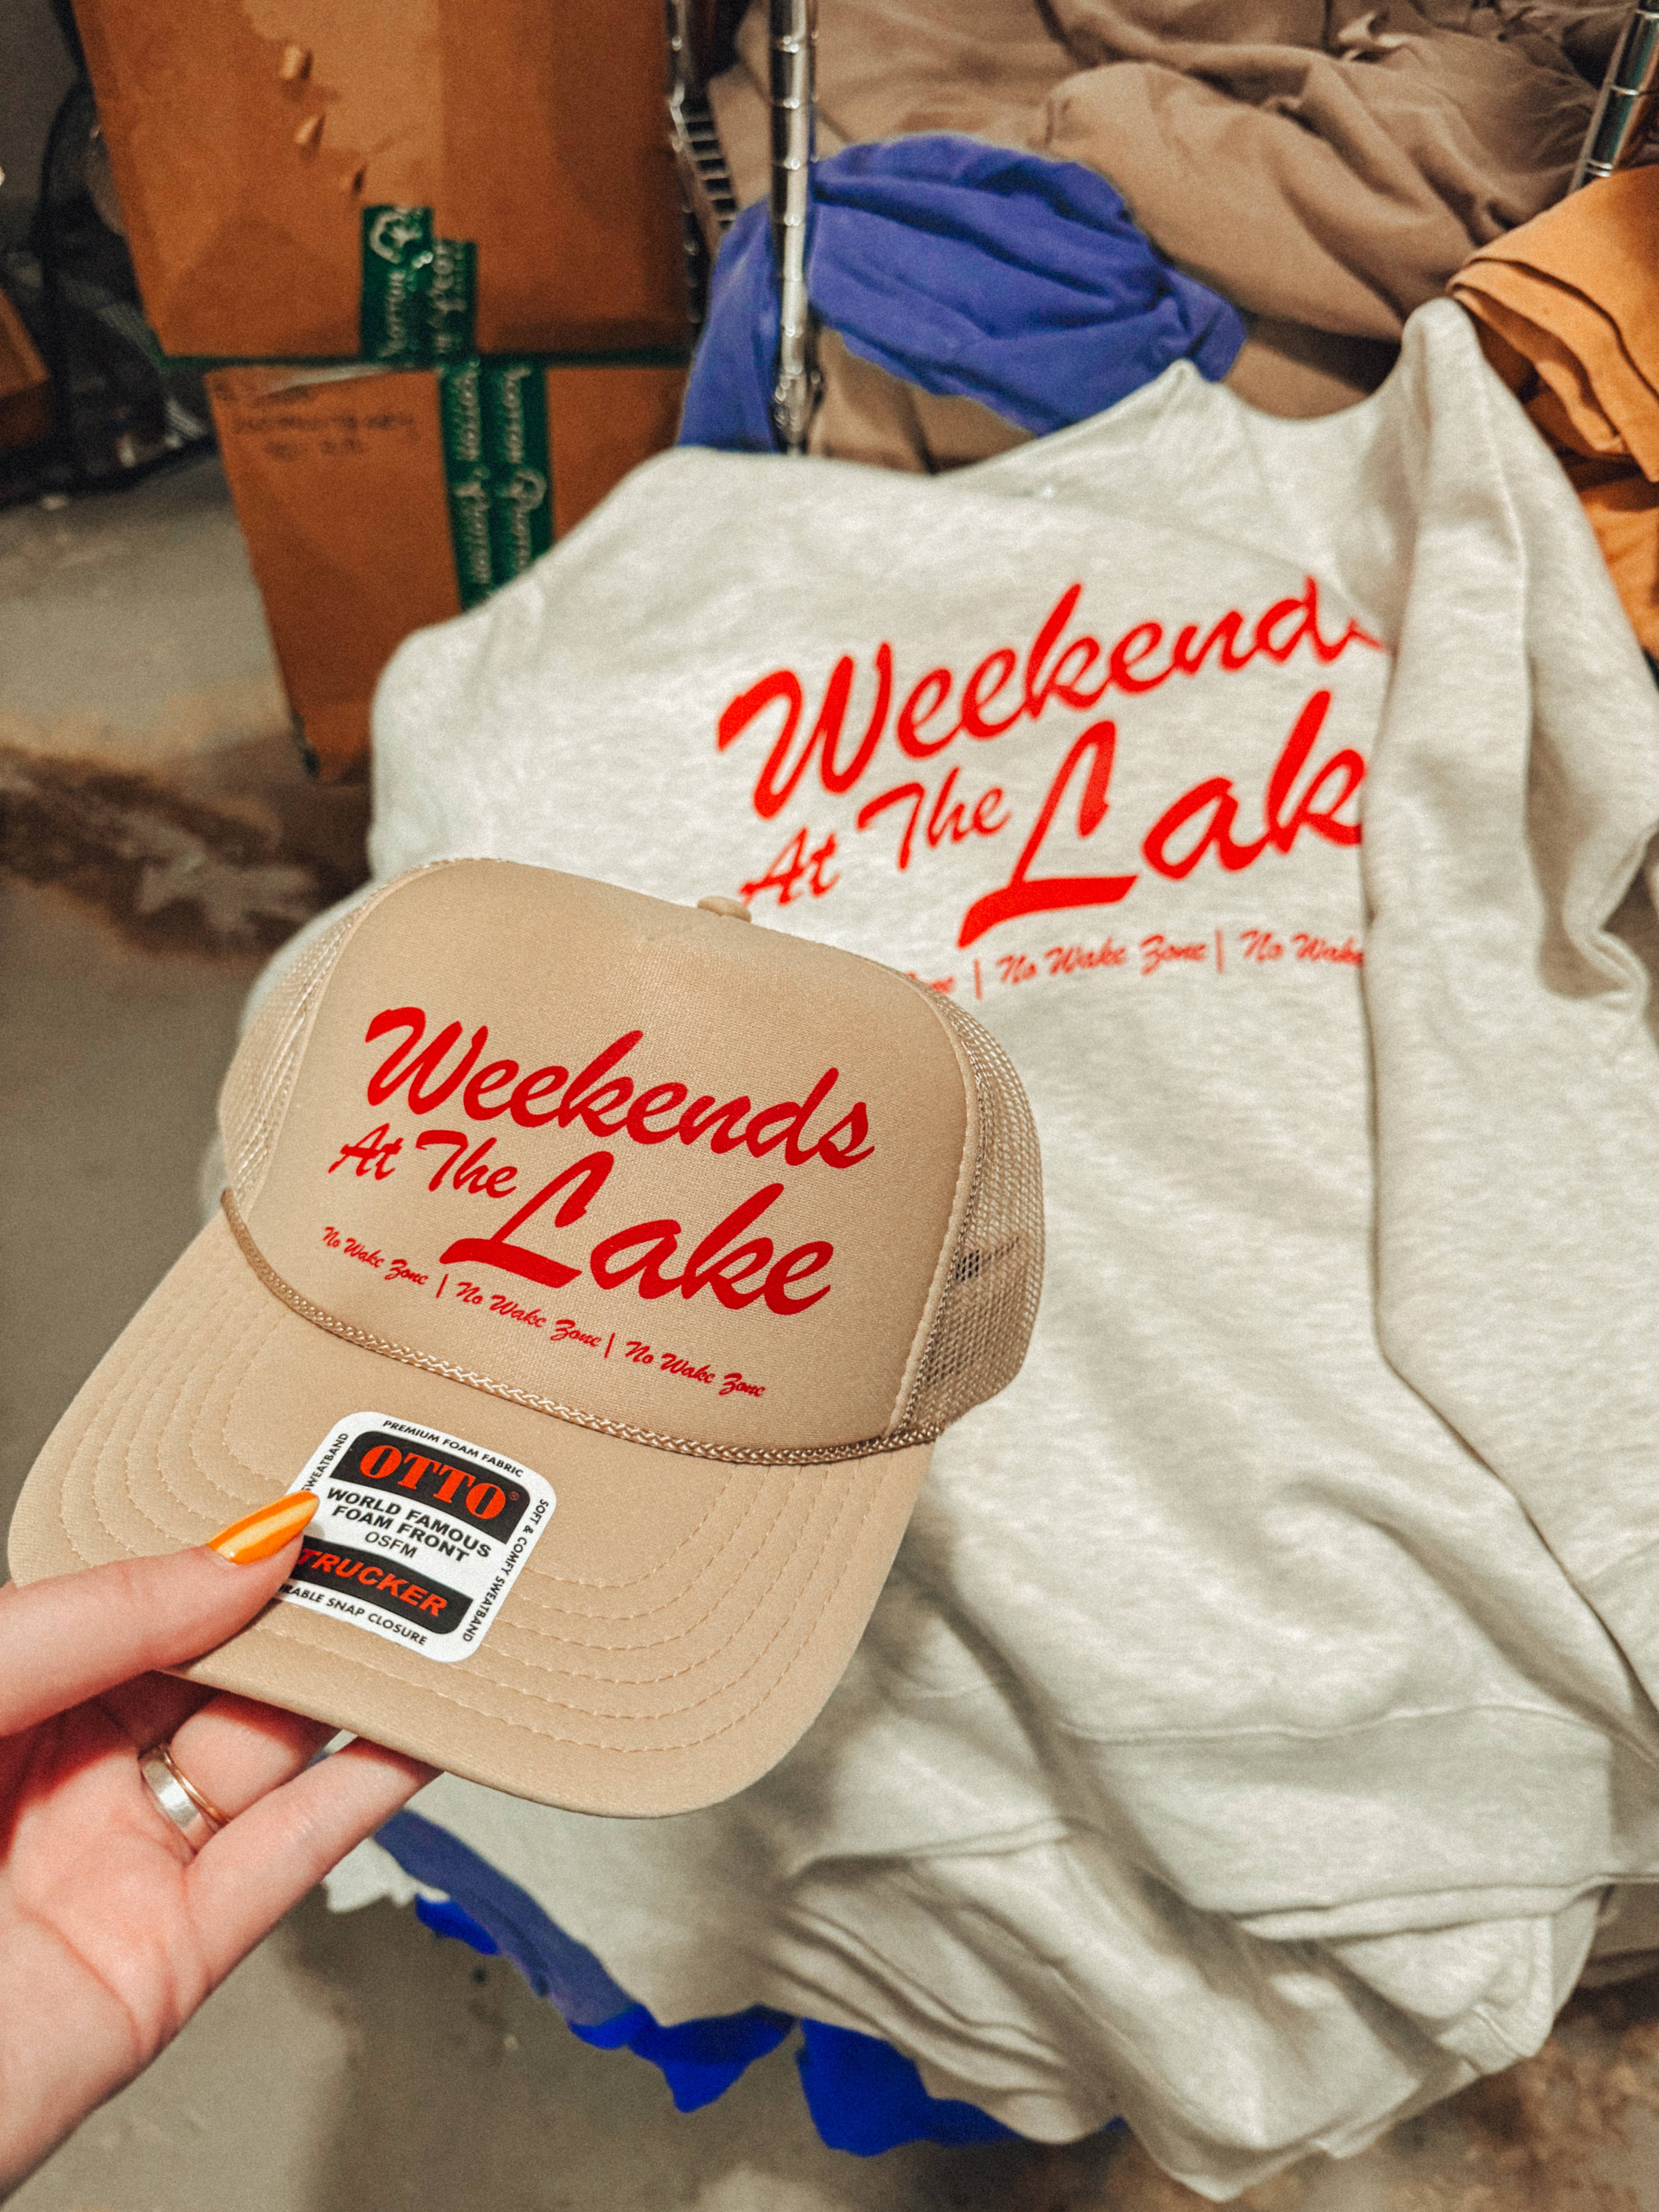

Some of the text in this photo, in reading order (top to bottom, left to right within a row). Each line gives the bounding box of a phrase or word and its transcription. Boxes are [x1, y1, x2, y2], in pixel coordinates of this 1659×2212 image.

[739, 689, 1369, 950] At The Lak
[996, 955, 1038, 984] No
[1044, 937, 1126, 975] Wake
[1140, 933, 1206, 975] Zone
[1240, 929, 1283, 962] No
[364, 1006, 875, 1170] Weekends
[328, 1122, 834, 1316] At The Lake
[323, 1226, 341, 1248] No
[343, 1237, 385, 1268] Wake
[384, 1259, 429, 1285] Zone
[456, 1281, 484, 1305] No
[489, 1294, 547, 1328] Wake
[550, 1319, 602, 1348] Zone
[624, 1341, 654, 1364] No
[660, 1352, 716, 1384] Wake
[718, 1372, 766, 1397] Zone
[359, 1445, 506, 1519] OTTO
[383, 1420, 524, 1478] PREMIUM FOAM FABRIC
[327, 1487, 491, 1558] WORLD FAMOUS
[331, 1505, 470, 1562] FOAM FRONT
[365, 1532, 418, 1558] OSFM
[296, 1548, 447, 1617] TRUCKER
[462, 1499, 548, 1642] SOFT & COMFY SWEATBAND
[326, 1598, 365, 1616] SNAP
[368, 1613, 428, 1645] CLOSURE
